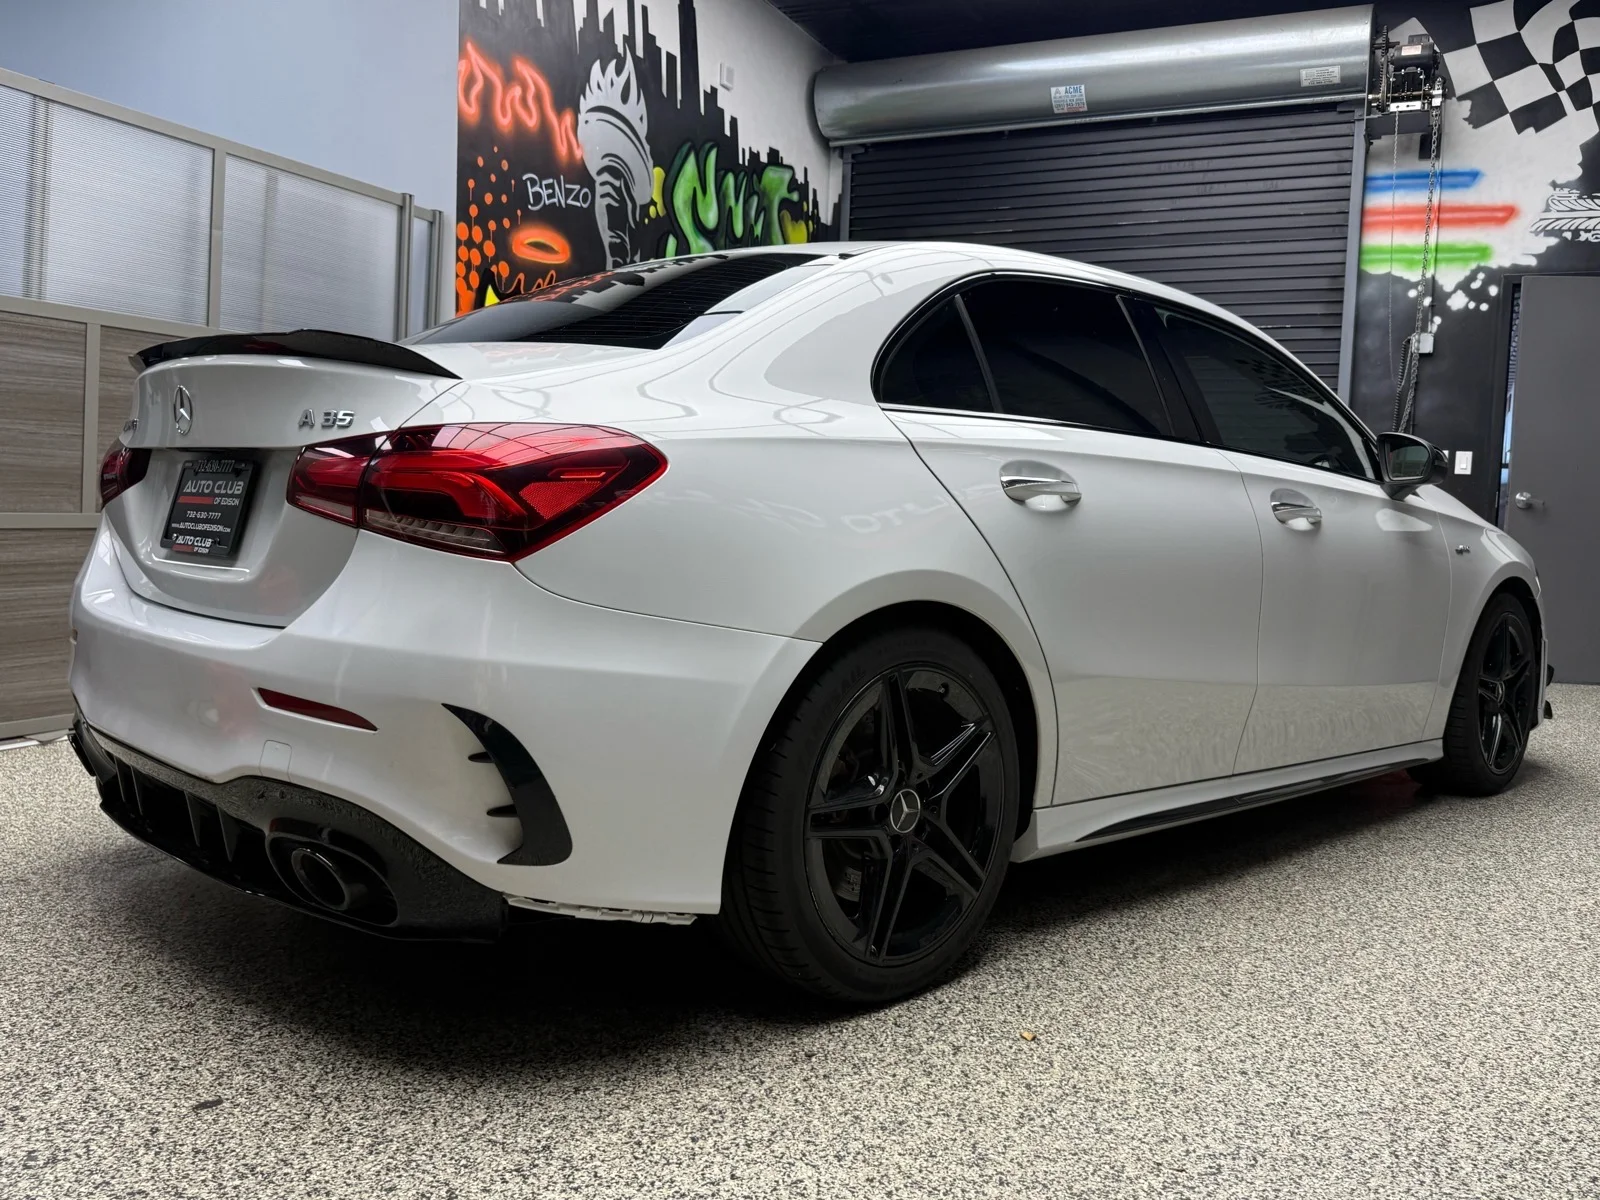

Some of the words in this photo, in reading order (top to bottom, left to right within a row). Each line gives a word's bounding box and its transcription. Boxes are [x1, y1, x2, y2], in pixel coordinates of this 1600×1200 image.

[1064, 85, 1082, 95] ACME
[522, 173, 591, 211] BENZO
[298, 409, 315, 429] A
[321, 410, 355, 429] 35
[183, 480, 213, 493] AUTO
[214, 480, 244, 494] CLUB
[214, 497, 221, 505] OF
[221, 497, 240, 506] EDISON
[186, 510, 221, 520] 732-630-7777
[176, 535, 194, 545] AUTO
[194, 536, 212, 548] CLUB
